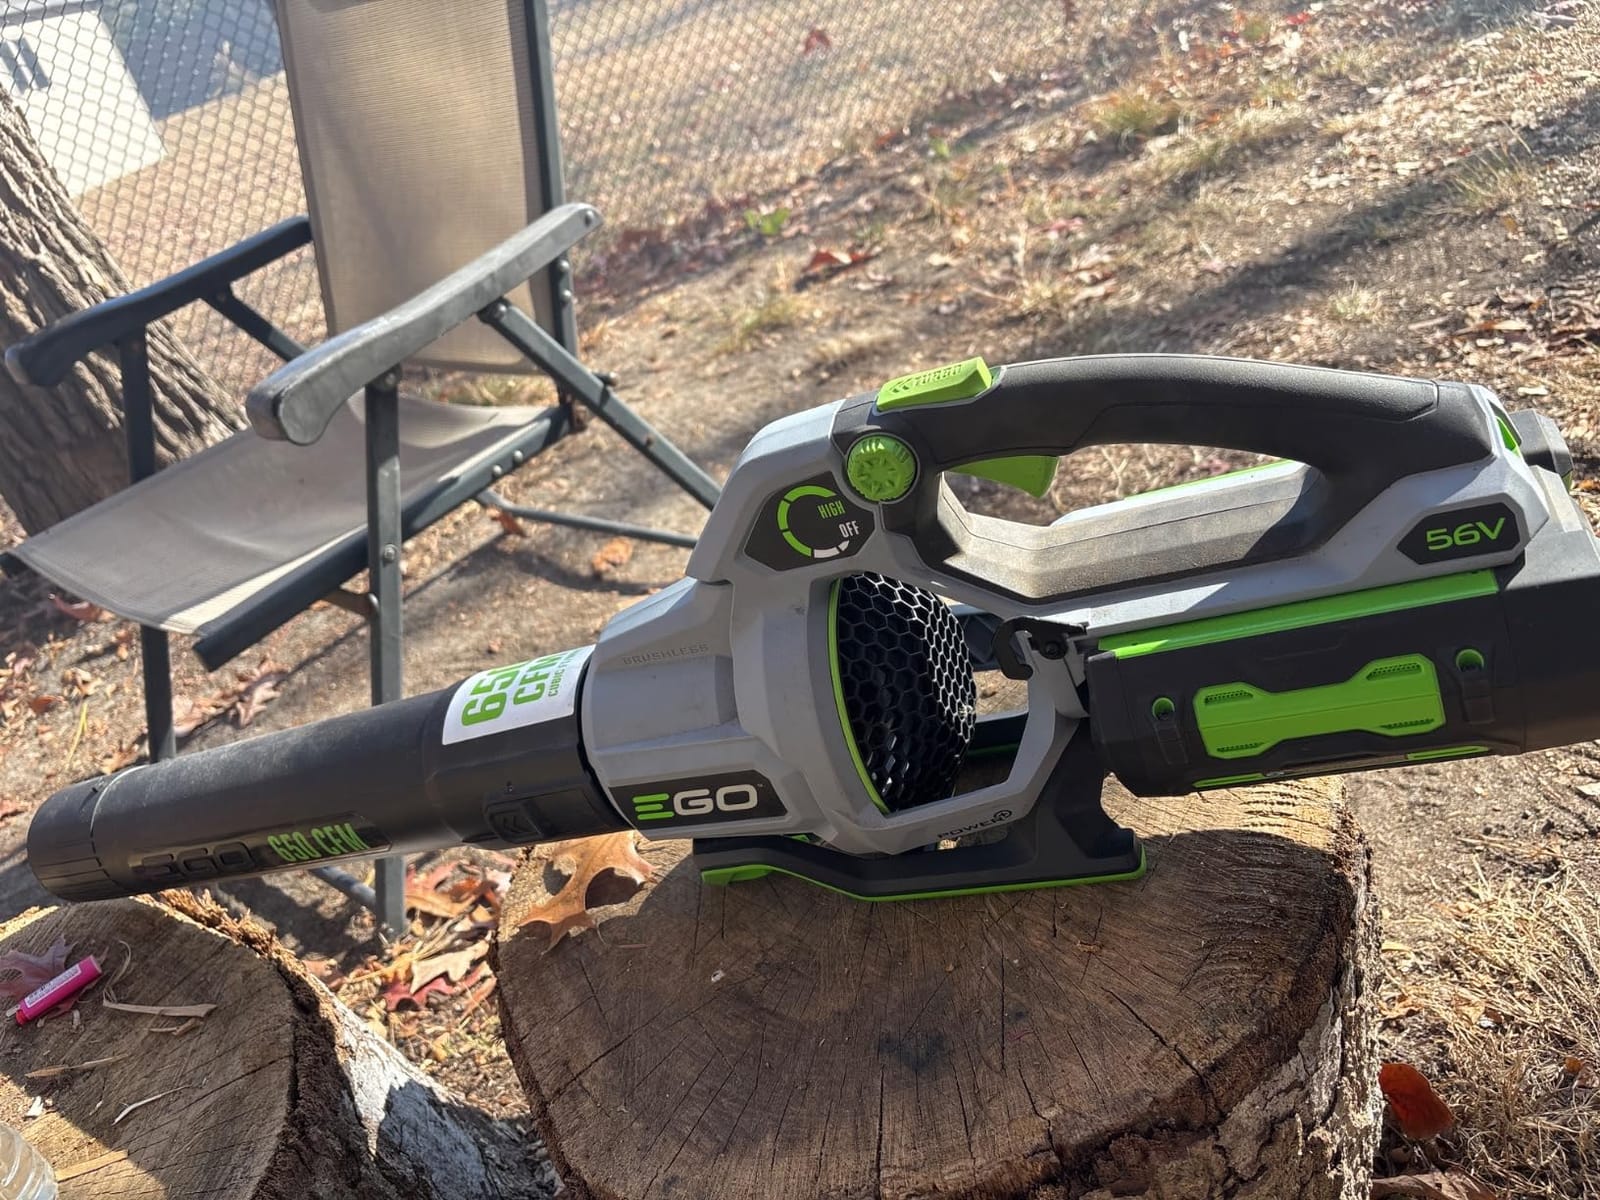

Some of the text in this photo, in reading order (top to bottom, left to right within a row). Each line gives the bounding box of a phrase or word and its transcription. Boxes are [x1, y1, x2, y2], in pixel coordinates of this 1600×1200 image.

[817, 500, 845, 519] HIGH
[838, 520, 860, 538] OFF
[1425, 516, 1506, 551] 56V
[632, 783, 758, 821] EGO
[267, 823, 370, 862] 650 CFM
